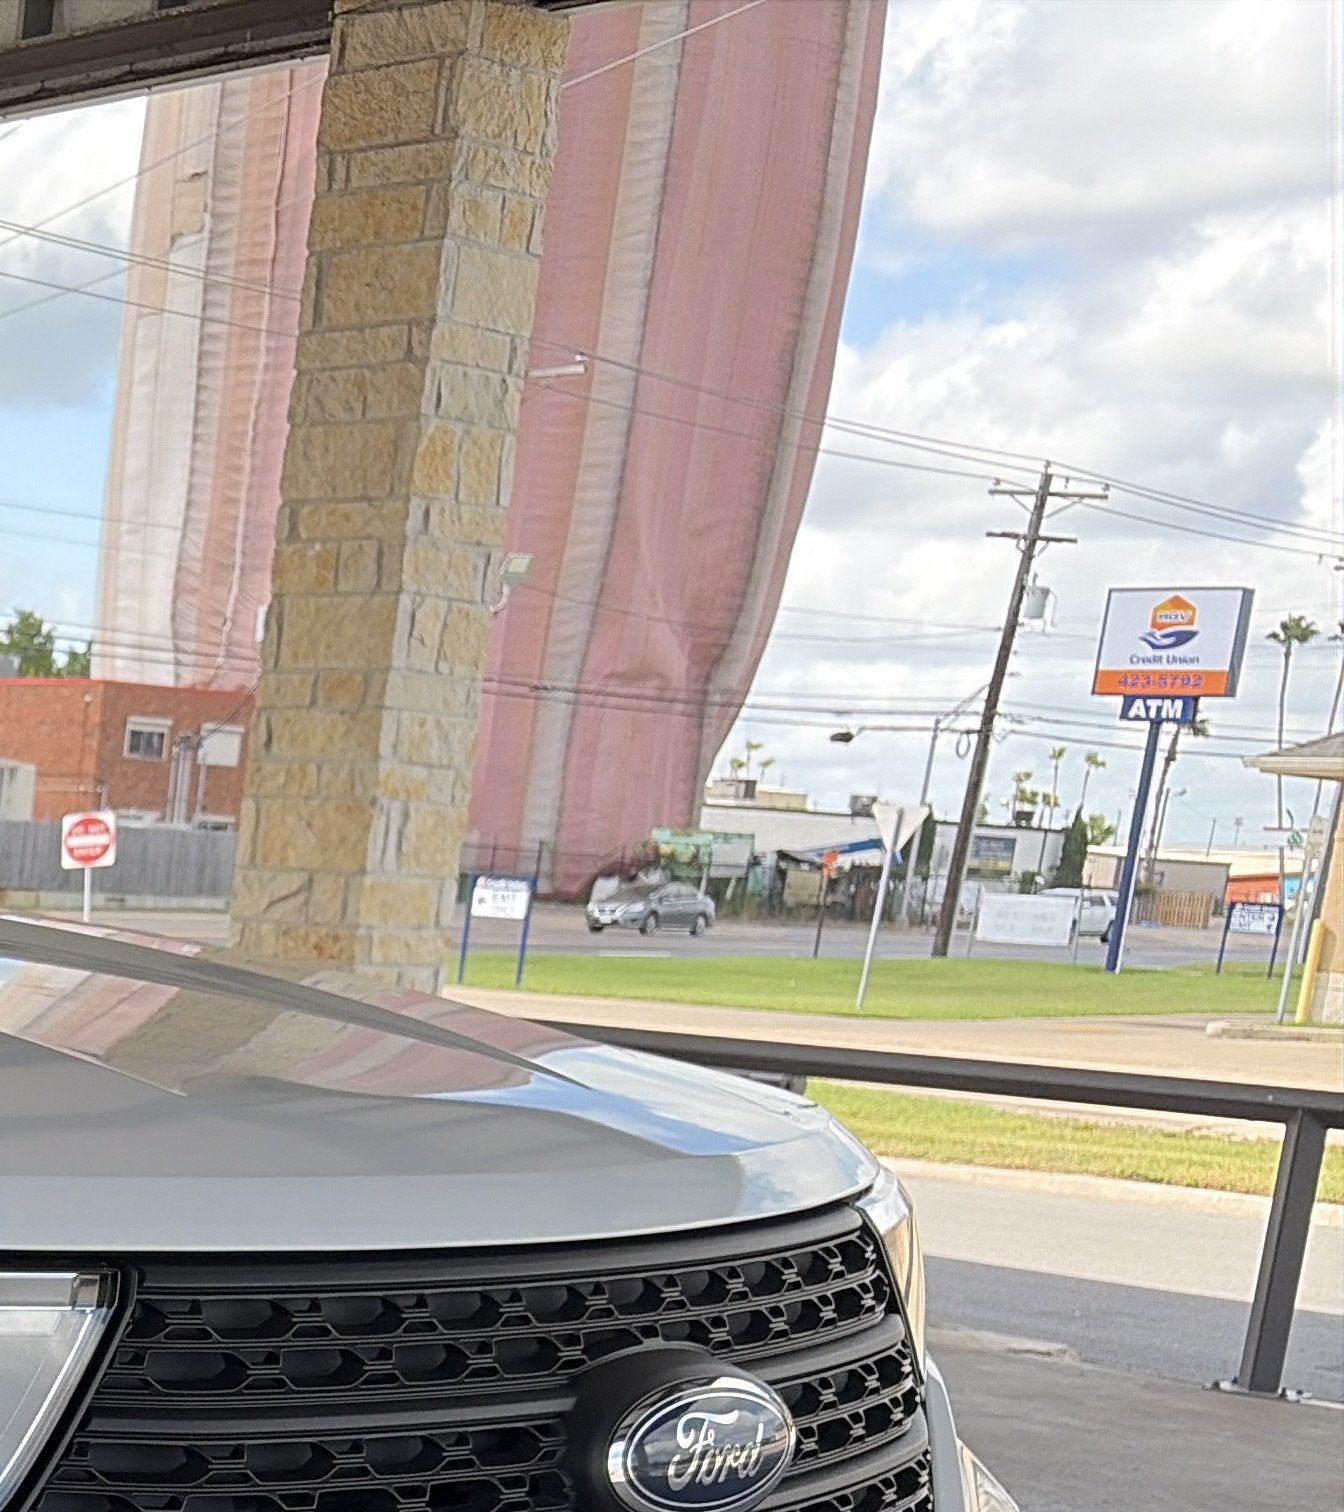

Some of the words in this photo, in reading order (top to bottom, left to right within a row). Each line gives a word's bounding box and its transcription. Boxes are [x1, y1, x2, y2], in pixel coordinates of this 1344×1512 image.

[1130, 654, 1163, 665] Credit
[1167, 654, 1200, 665] Union
[1128, 698, 1184, 719] ATM
[667, 1409, 764, 1491] Ford
